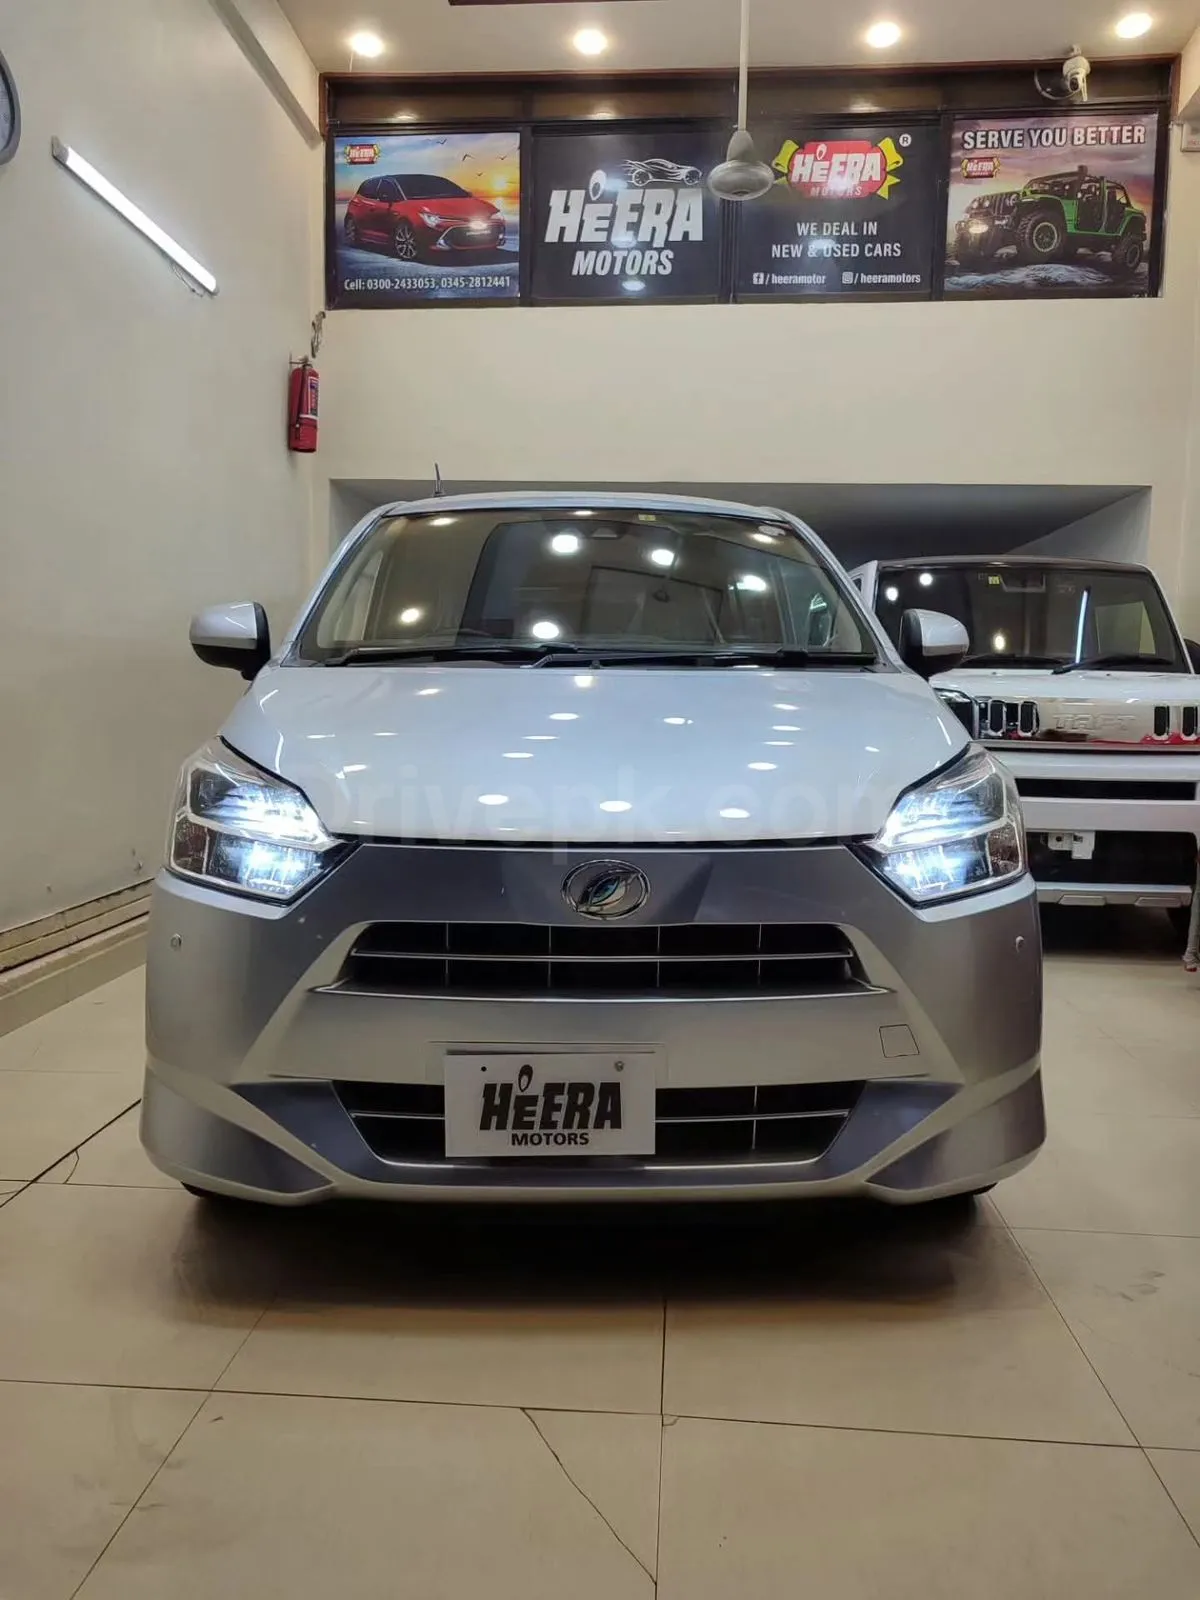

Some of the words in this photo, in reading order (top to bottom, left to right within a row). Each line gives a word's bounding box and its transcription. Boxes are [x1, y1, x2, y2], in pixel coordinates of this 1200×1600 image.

[963, 130, 1024, 149] SERVE
[1028, 128, 1067, 147] YOU
[1073, 125, 1146, 145] BETTER
[796, 222, 818, 236] WE
[823, 222, 858, 235] DEAL
[863, 221, 878, 235] IN
[771, 245, 802, 259] NEW
[823, 244, 860, 257] USED
[864, 243, 902, 257] CARS
[571, 250, 674, 276] MOTORS
[344, 278, 365, 291] Cell:
[366, 277, 439, 291] 0300-2433053,
[441, 276, 511, 289] 0345-2812441
[511, 1132, 589, 1146] MOTORS
